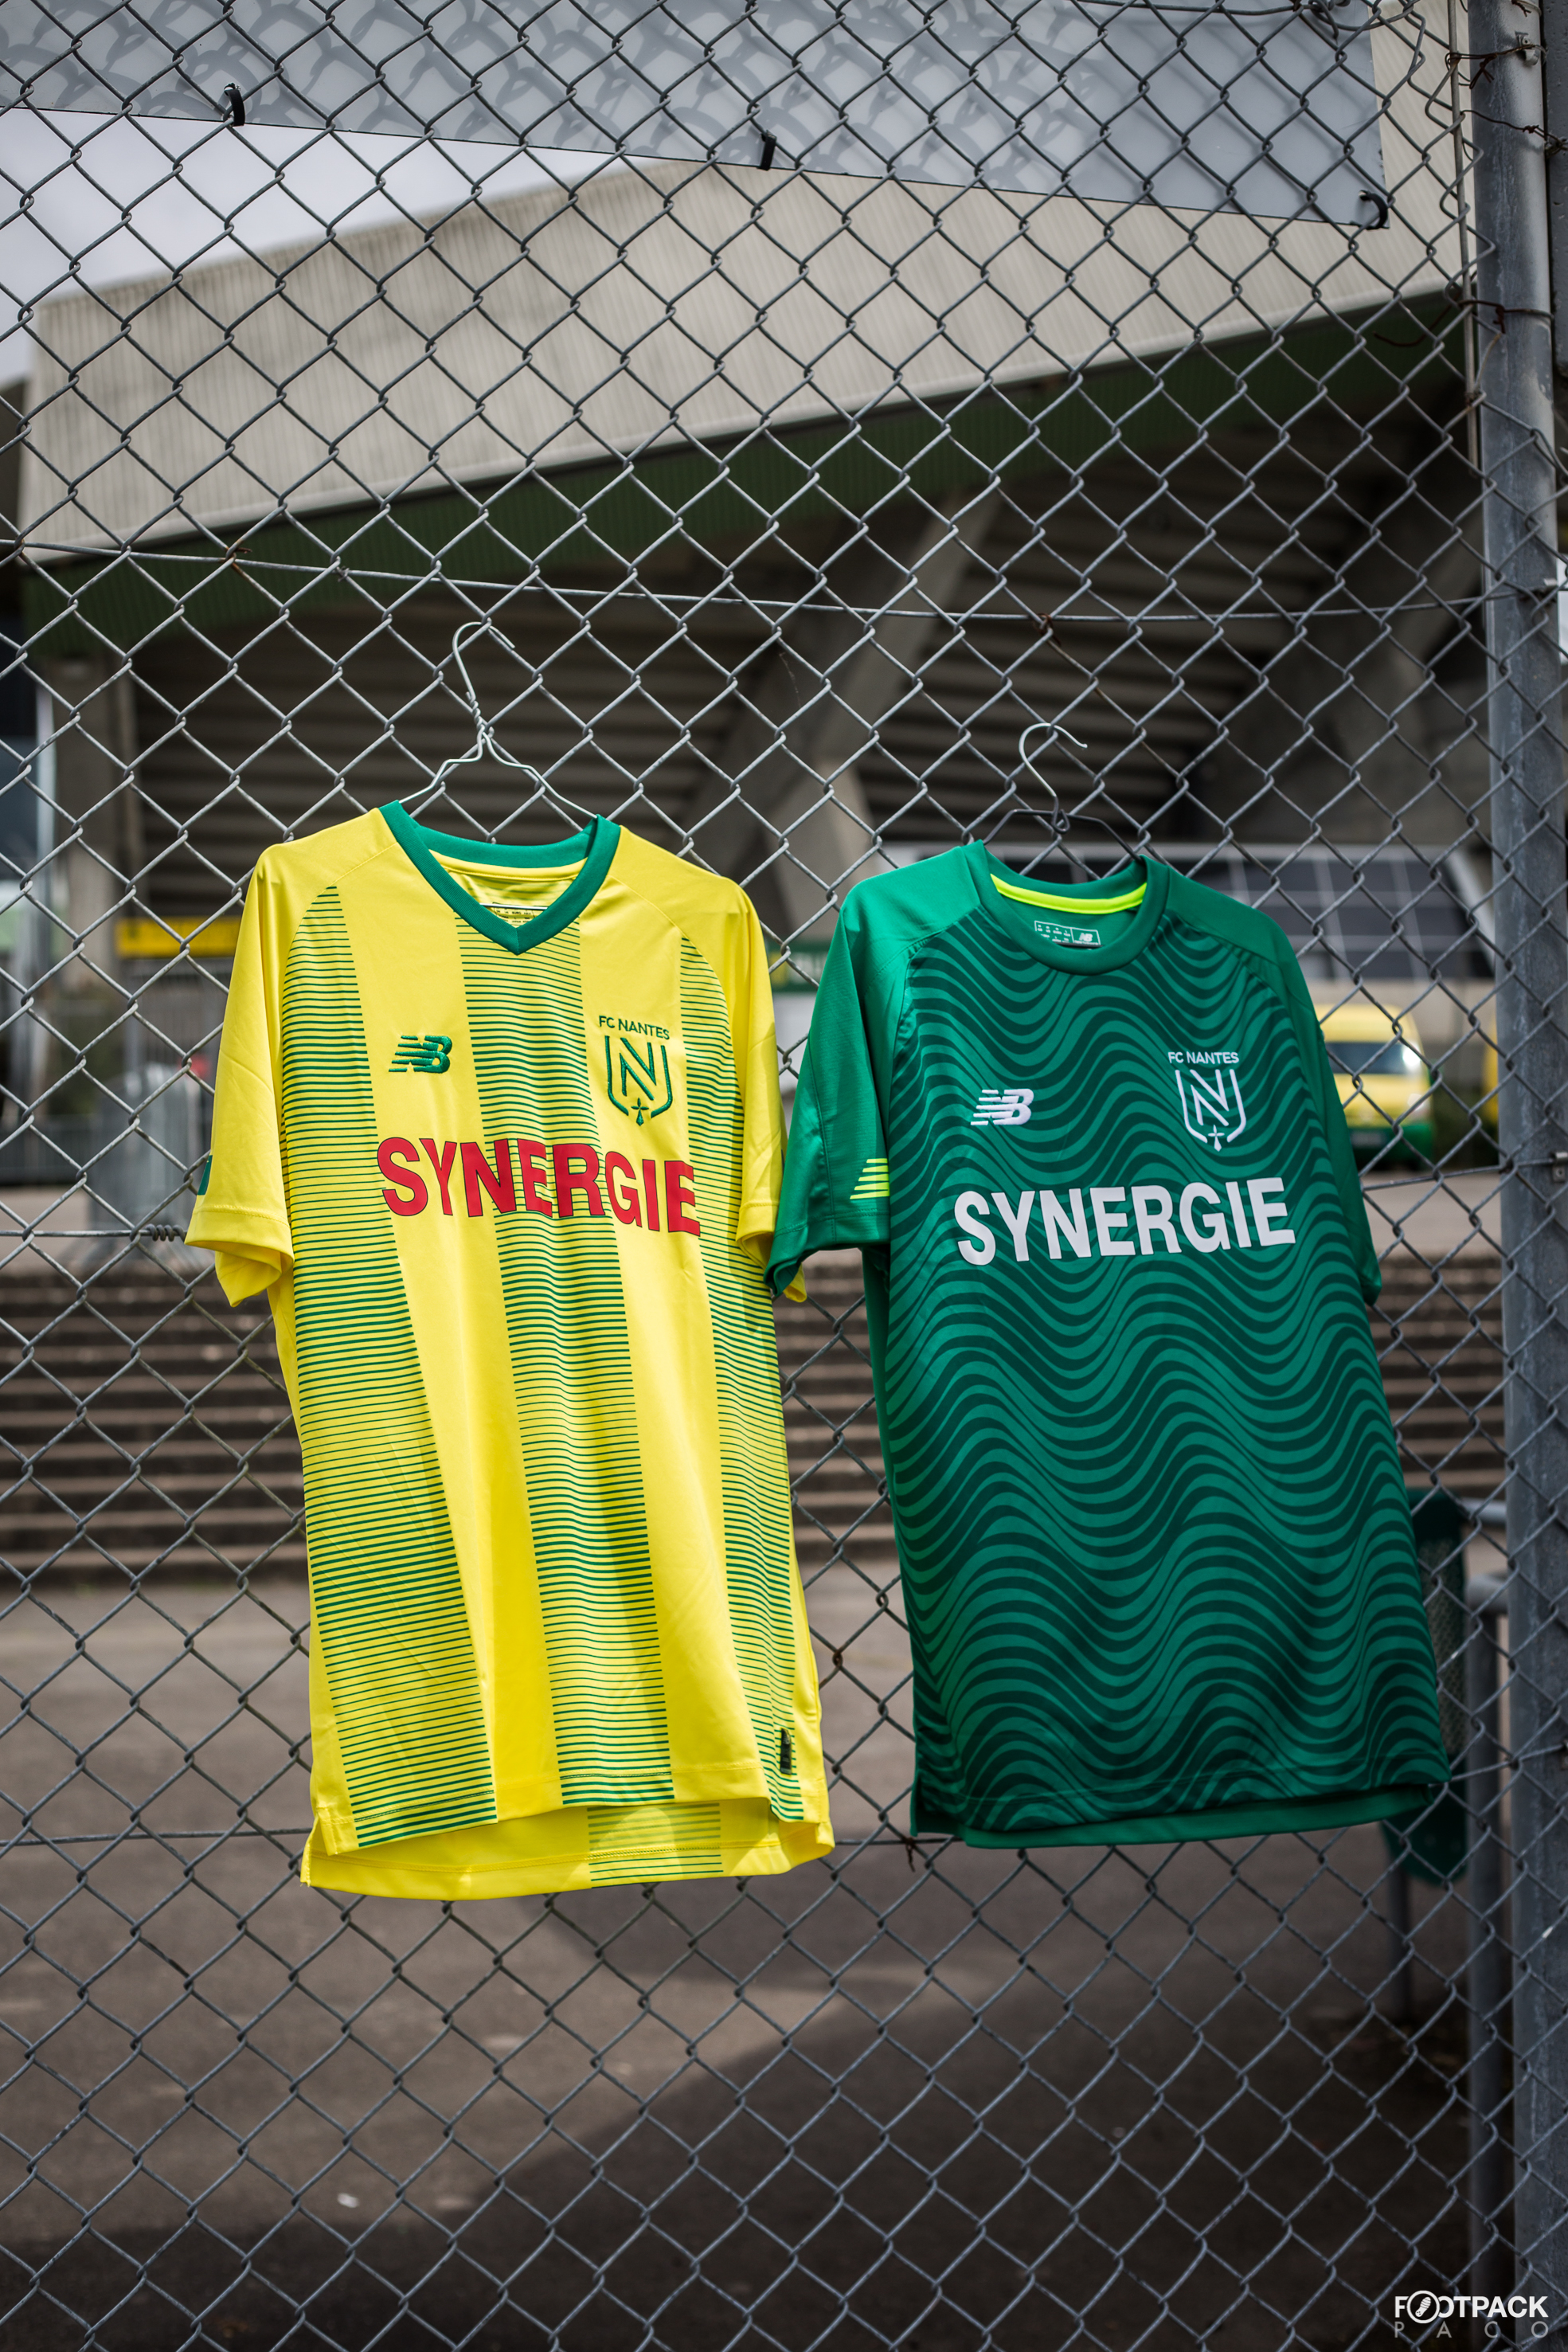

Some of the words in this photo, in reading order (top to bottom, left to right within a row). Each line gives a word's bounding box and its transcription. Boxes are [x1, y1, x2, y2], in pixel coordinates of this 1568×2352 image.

[599, 1016, 615, 1028] FC
[618, 1019, 670, 1039] NANTES
[1167, 1052, 1184, 1064] FC
[1186, 1051, 1240, 1065] NANTES
[377, 1137, 701, 1237] SYNERGIE
[954, 1177, 1296, 1266] SYNERGIE
